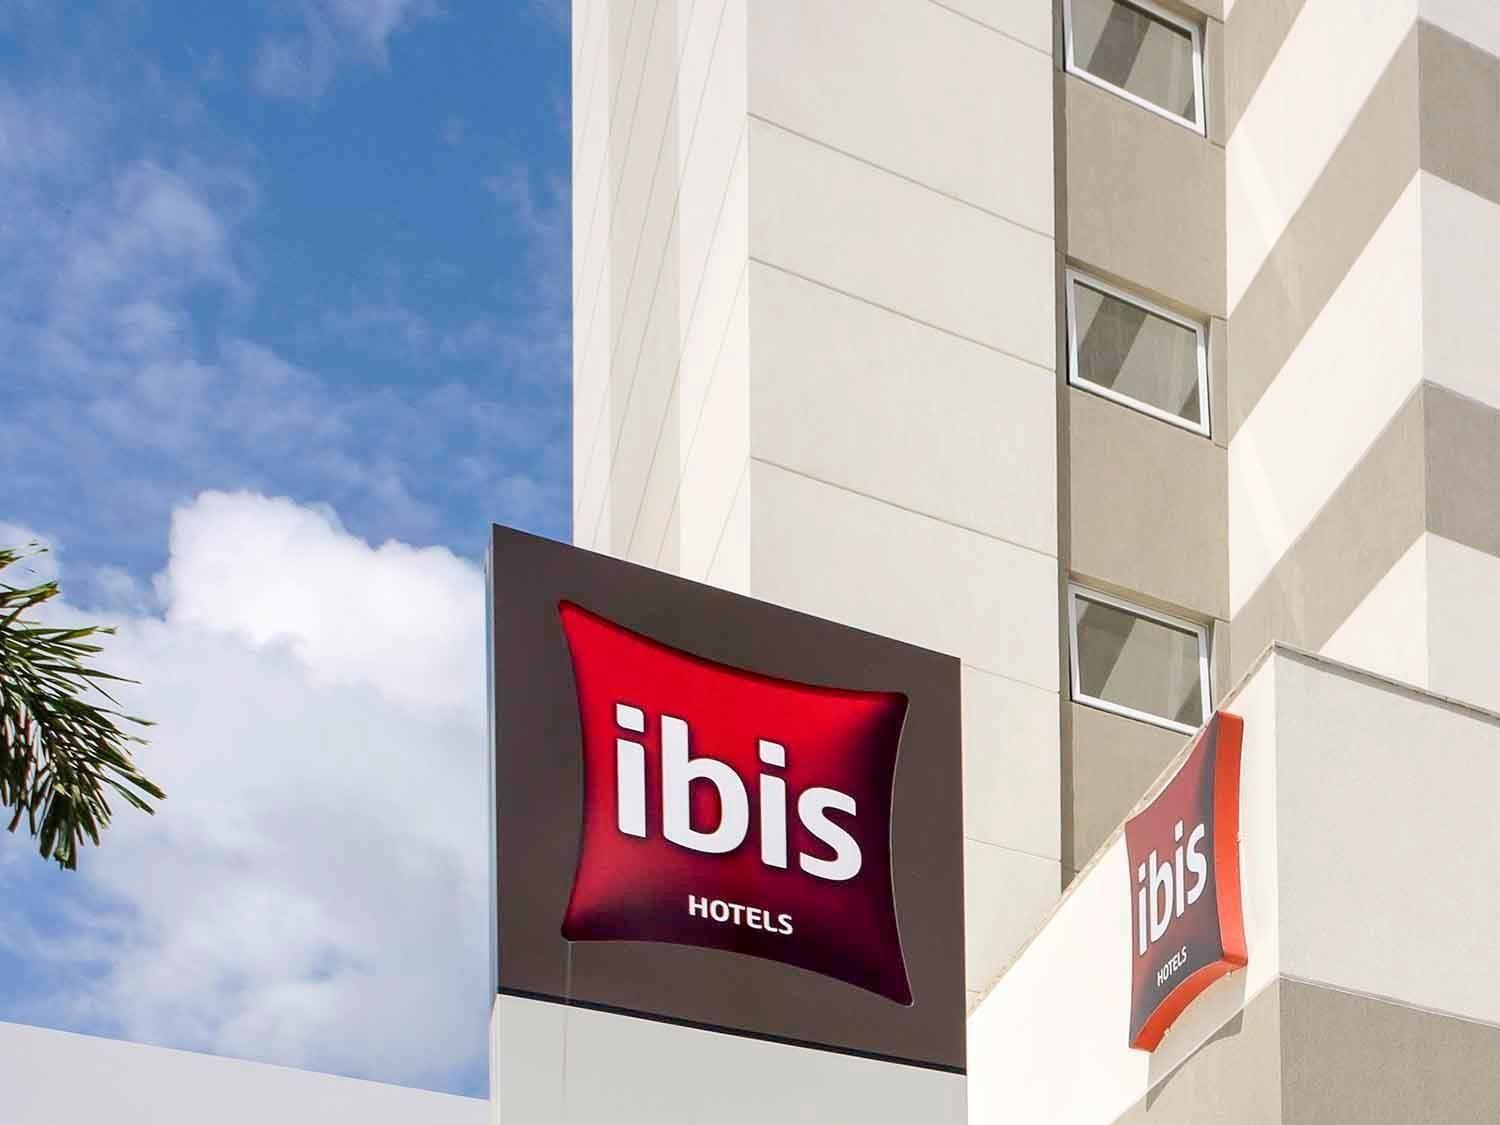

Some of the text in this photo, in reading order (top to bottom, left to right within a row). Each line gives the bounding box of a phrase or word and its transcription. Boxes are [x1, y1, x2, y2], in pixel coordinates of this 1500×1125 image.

[616, 703, 863, 881] ibis
[688, 894, 793, 935] HOTELS
[1138, 820, 1208, 956] ibis
[1157, 946, 1189, 987] HOTELS
